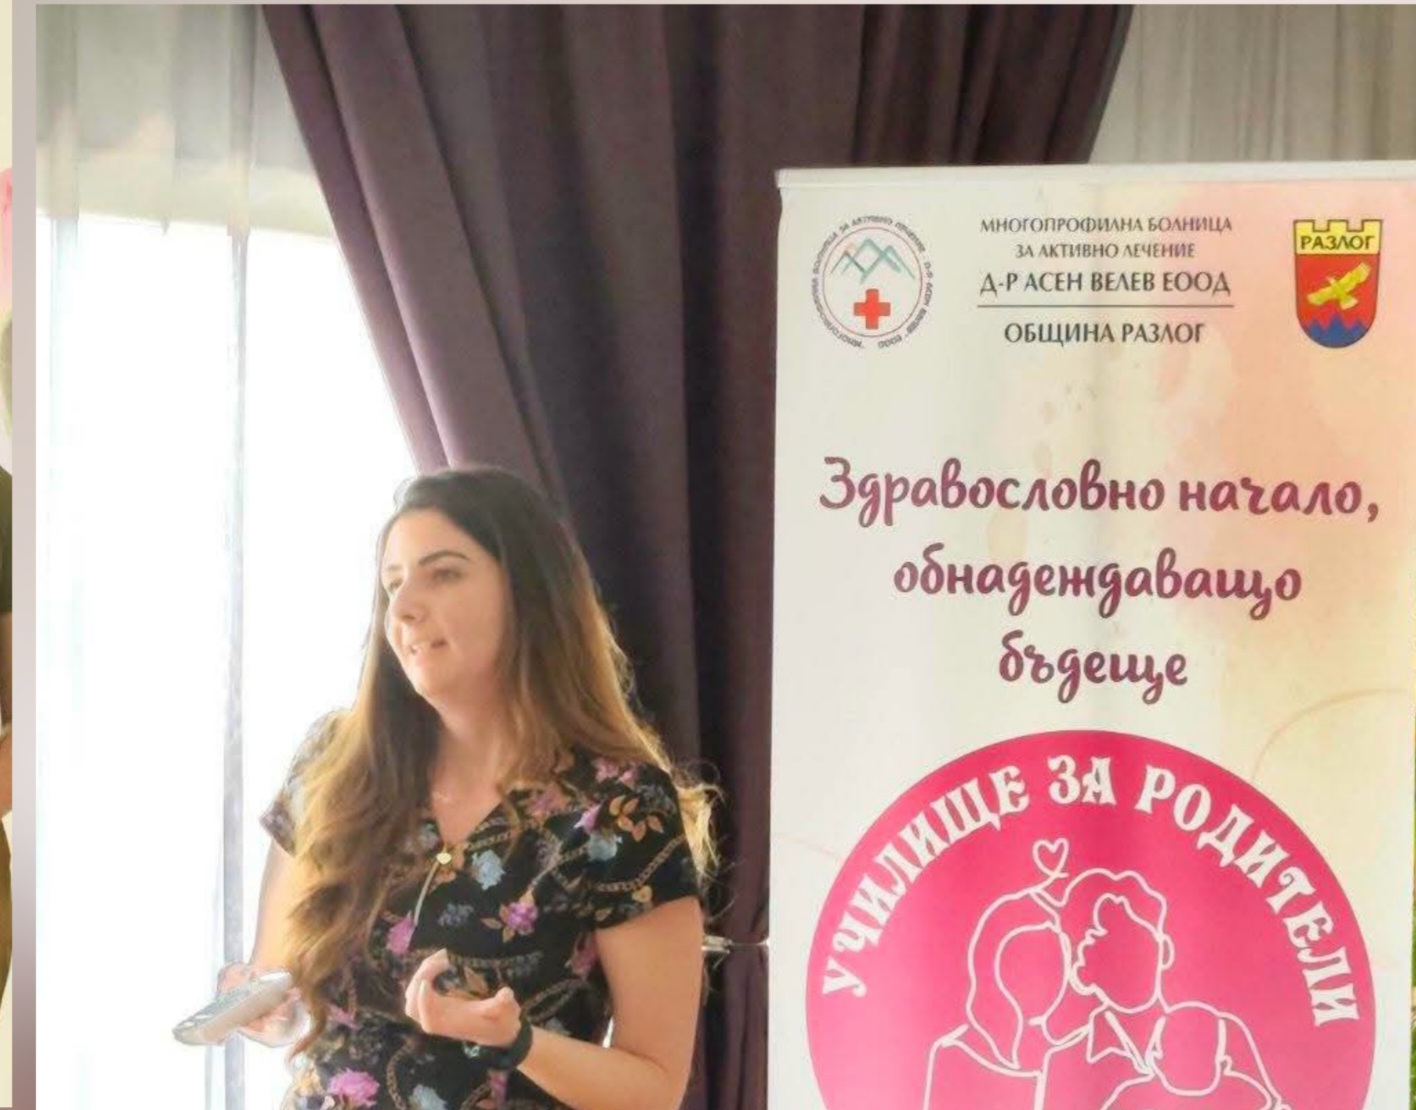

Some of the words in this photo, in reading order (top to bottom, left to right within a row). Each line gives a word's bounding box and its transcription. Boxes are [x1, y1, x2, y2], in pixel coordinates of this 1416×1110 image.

[980, 216, 1144, 234] МНОГОПРОФИЛНА
[1147, 216, 1233, 235] БОЛНИЦА
[1016, 243, 1035, 259] ЗА
[1038, 242, 1120, 259] АКТИВНО
[1124, 242, 1195, 258] ЛЕЧЕНИЕ
[1300, 235, 1375, 251] РАЗЛОГ
[979, 272, 1019, 297] Д-Р
[1023, 271, 1083, 293] АСЕН
[1090, 271, 1155, 292] ВЕЛЕВ
[1162, 271, 1231, 297] ЕООД
[1004, 322, 1116, 348] ОБЩИНА
[1121, 322, 1205, 344] РАЗЛОГ
[819, 456, 1166, 527] Здравословно
[1178, 476, 1380, 523] начало,
[893, 542, 1302, 621] обнадеждаващо
[998, 629, 1188, 706] бъдеще
[822, 764, 1030, 998] УЧИЛИЩЕ
[1047, 754, 1117, 806] ЗА
[1135, 763, 1361, 1028] РОДИТЕЛИ
